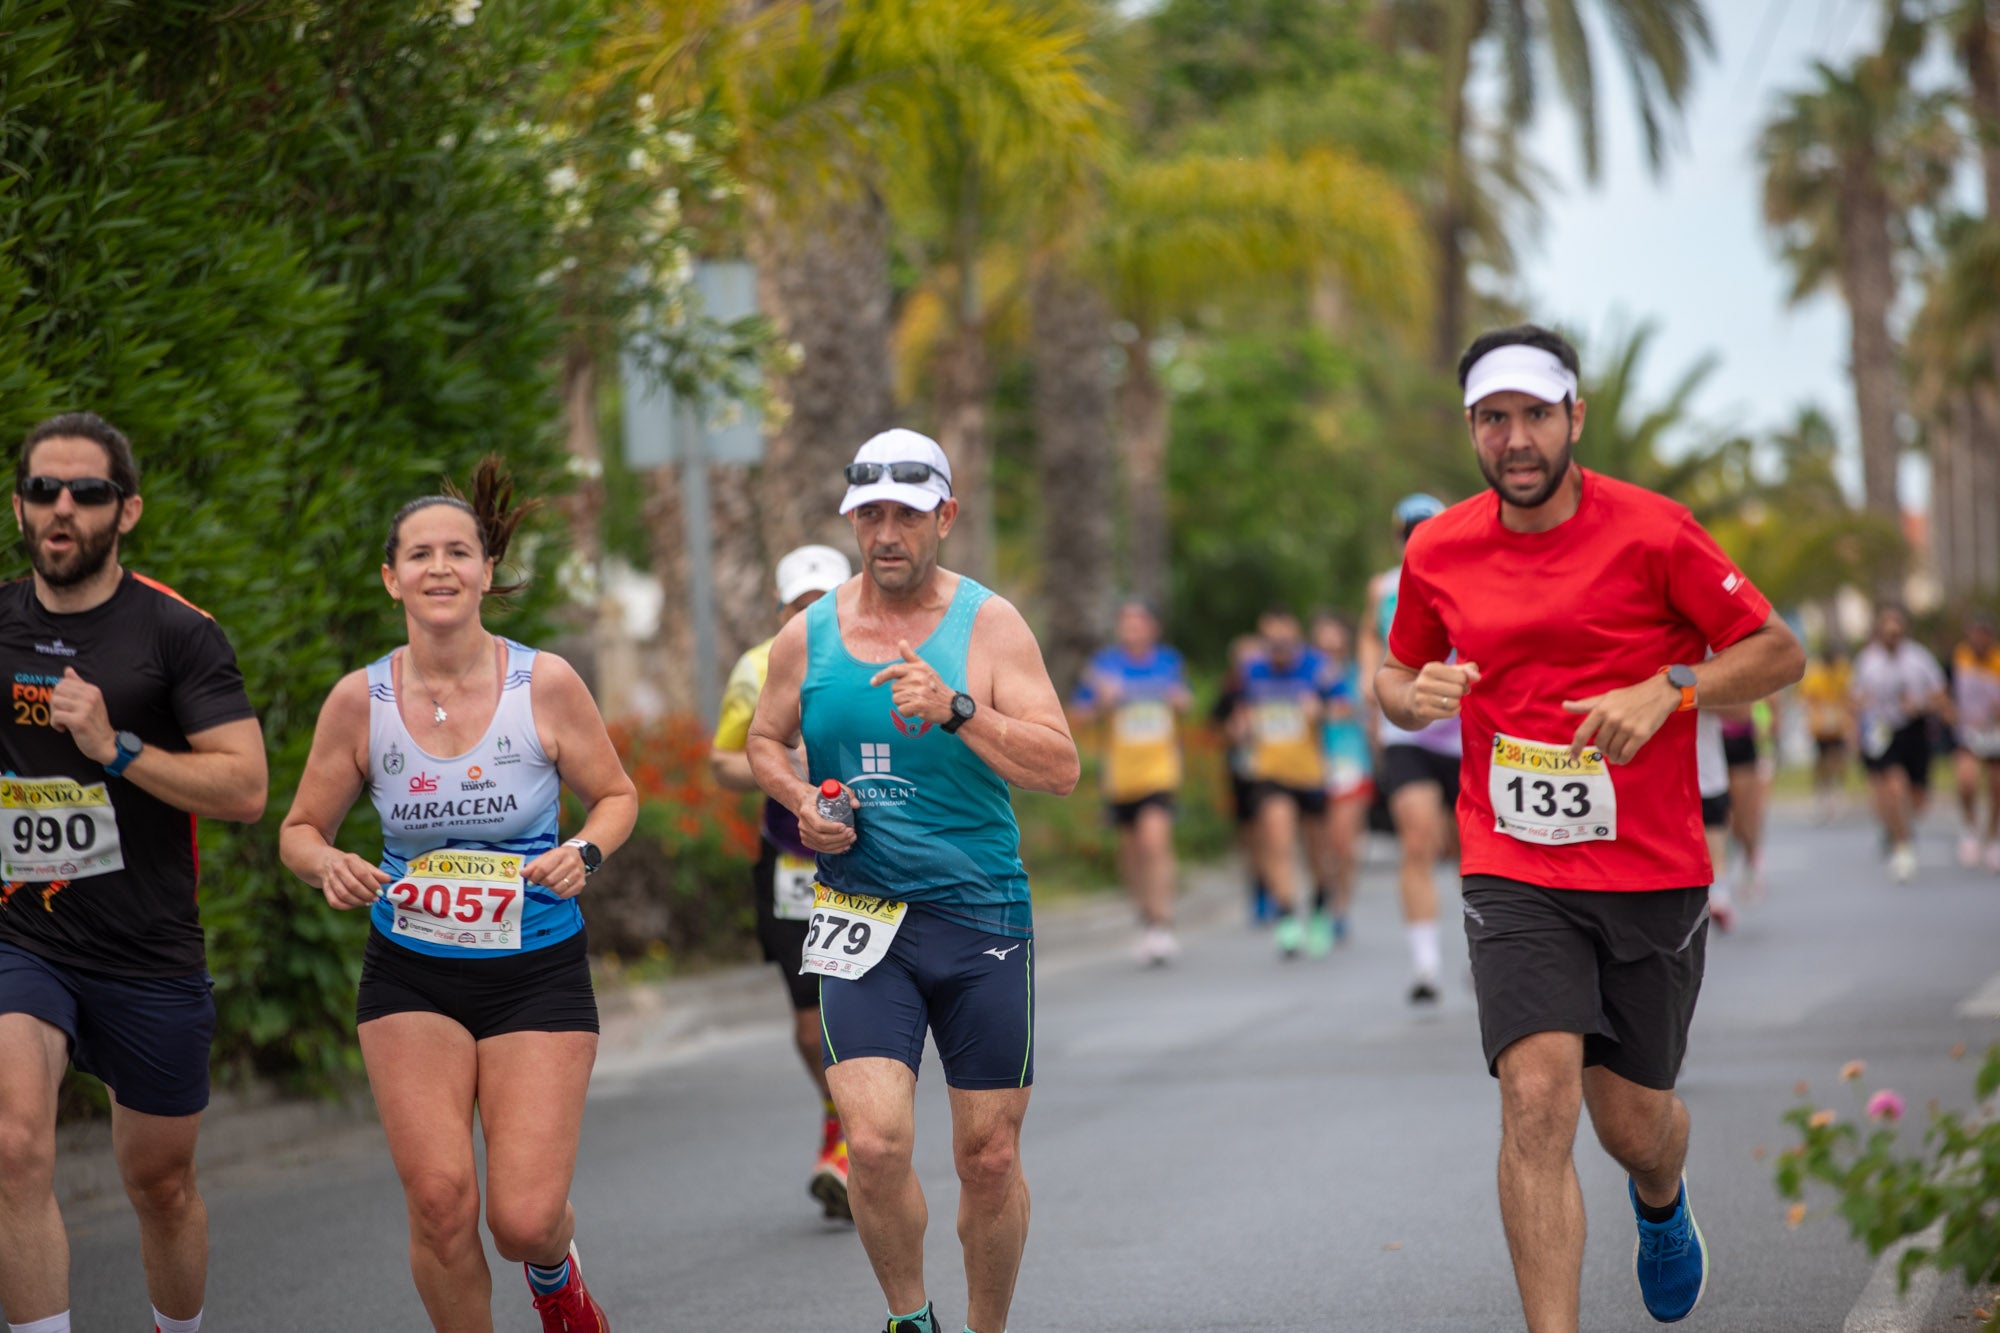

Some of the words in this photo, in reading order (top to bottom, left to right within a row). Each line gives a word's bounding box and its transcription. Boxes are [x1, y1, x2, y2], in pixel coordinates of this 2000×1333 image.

[15, 672, 43, 684] GRAN
[1521, 752, 1581, 770] FONDO
[853, 787, 917, 799] NOVENT
[1507, 776, 1591, 818] 133
[391, 794, 518, 820] MARACENA
[447, 817, 505, 827] ATLETISMO
[13, 813, 96, 854] 990
[428, 860, 495, 875] FONDO
[433, 854, 456, 862] GRAN
[457, 855, 489, 863] PREMIO
[392, 883, 516, 923] 2057
[808, 913, 872, 955] 679
